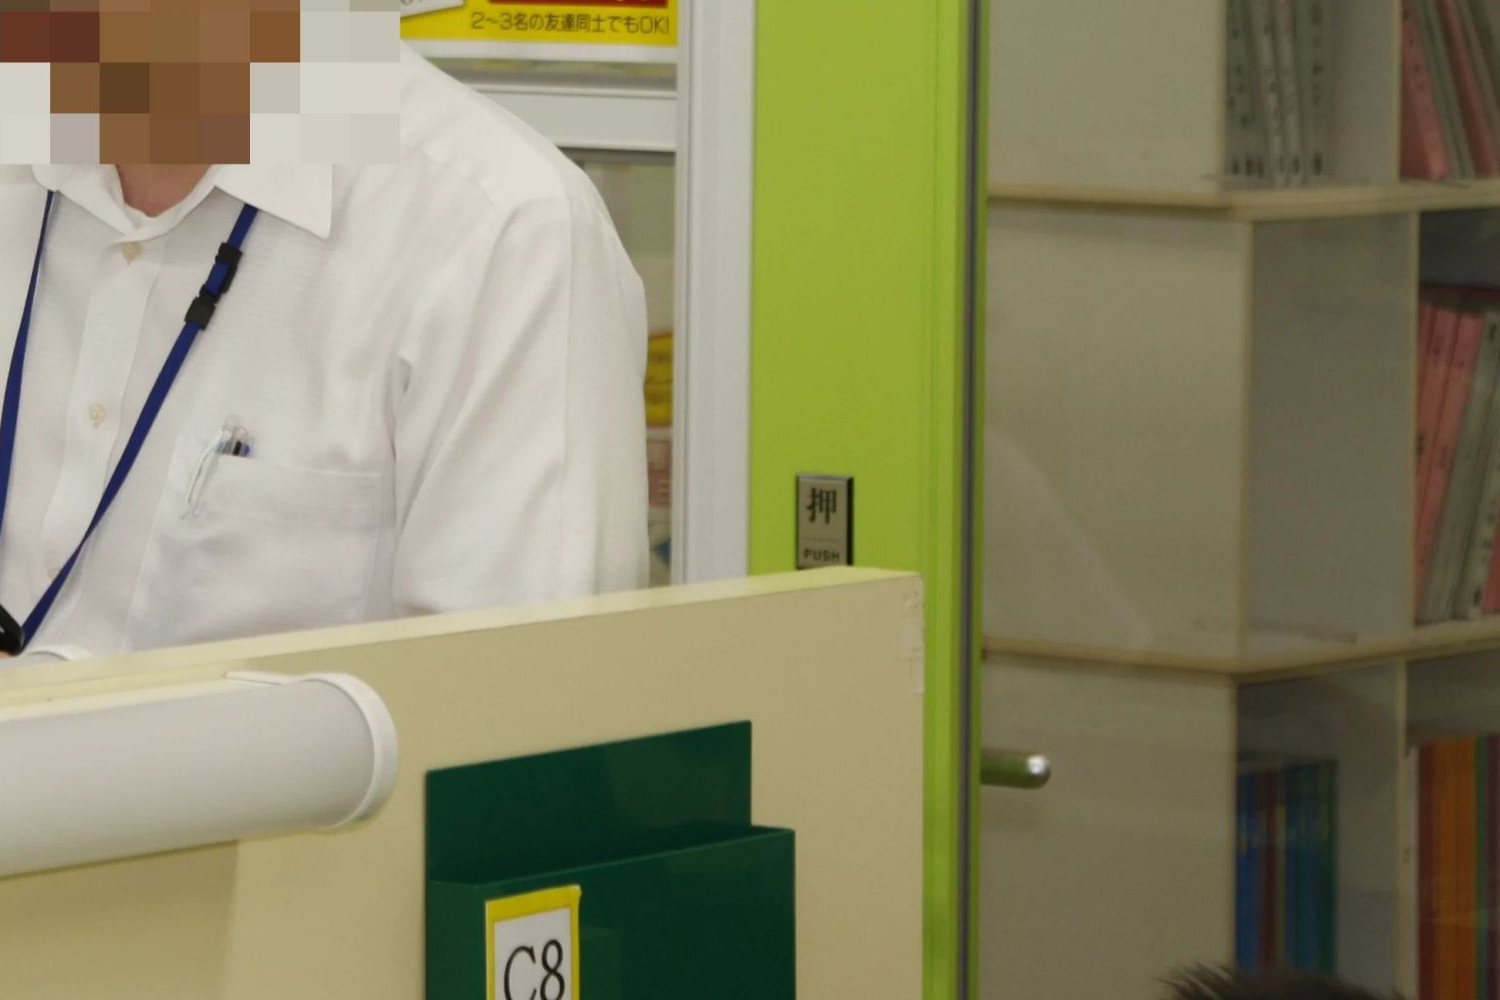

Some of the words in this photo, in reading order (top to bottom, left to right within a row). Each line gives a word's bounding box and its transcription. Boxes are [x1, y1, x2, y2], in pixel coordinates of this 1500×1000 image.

[806, 487, 837, 524] 押
[804, 548, 840, 562] PUSH
[504, 938, 566, 1000] C8
